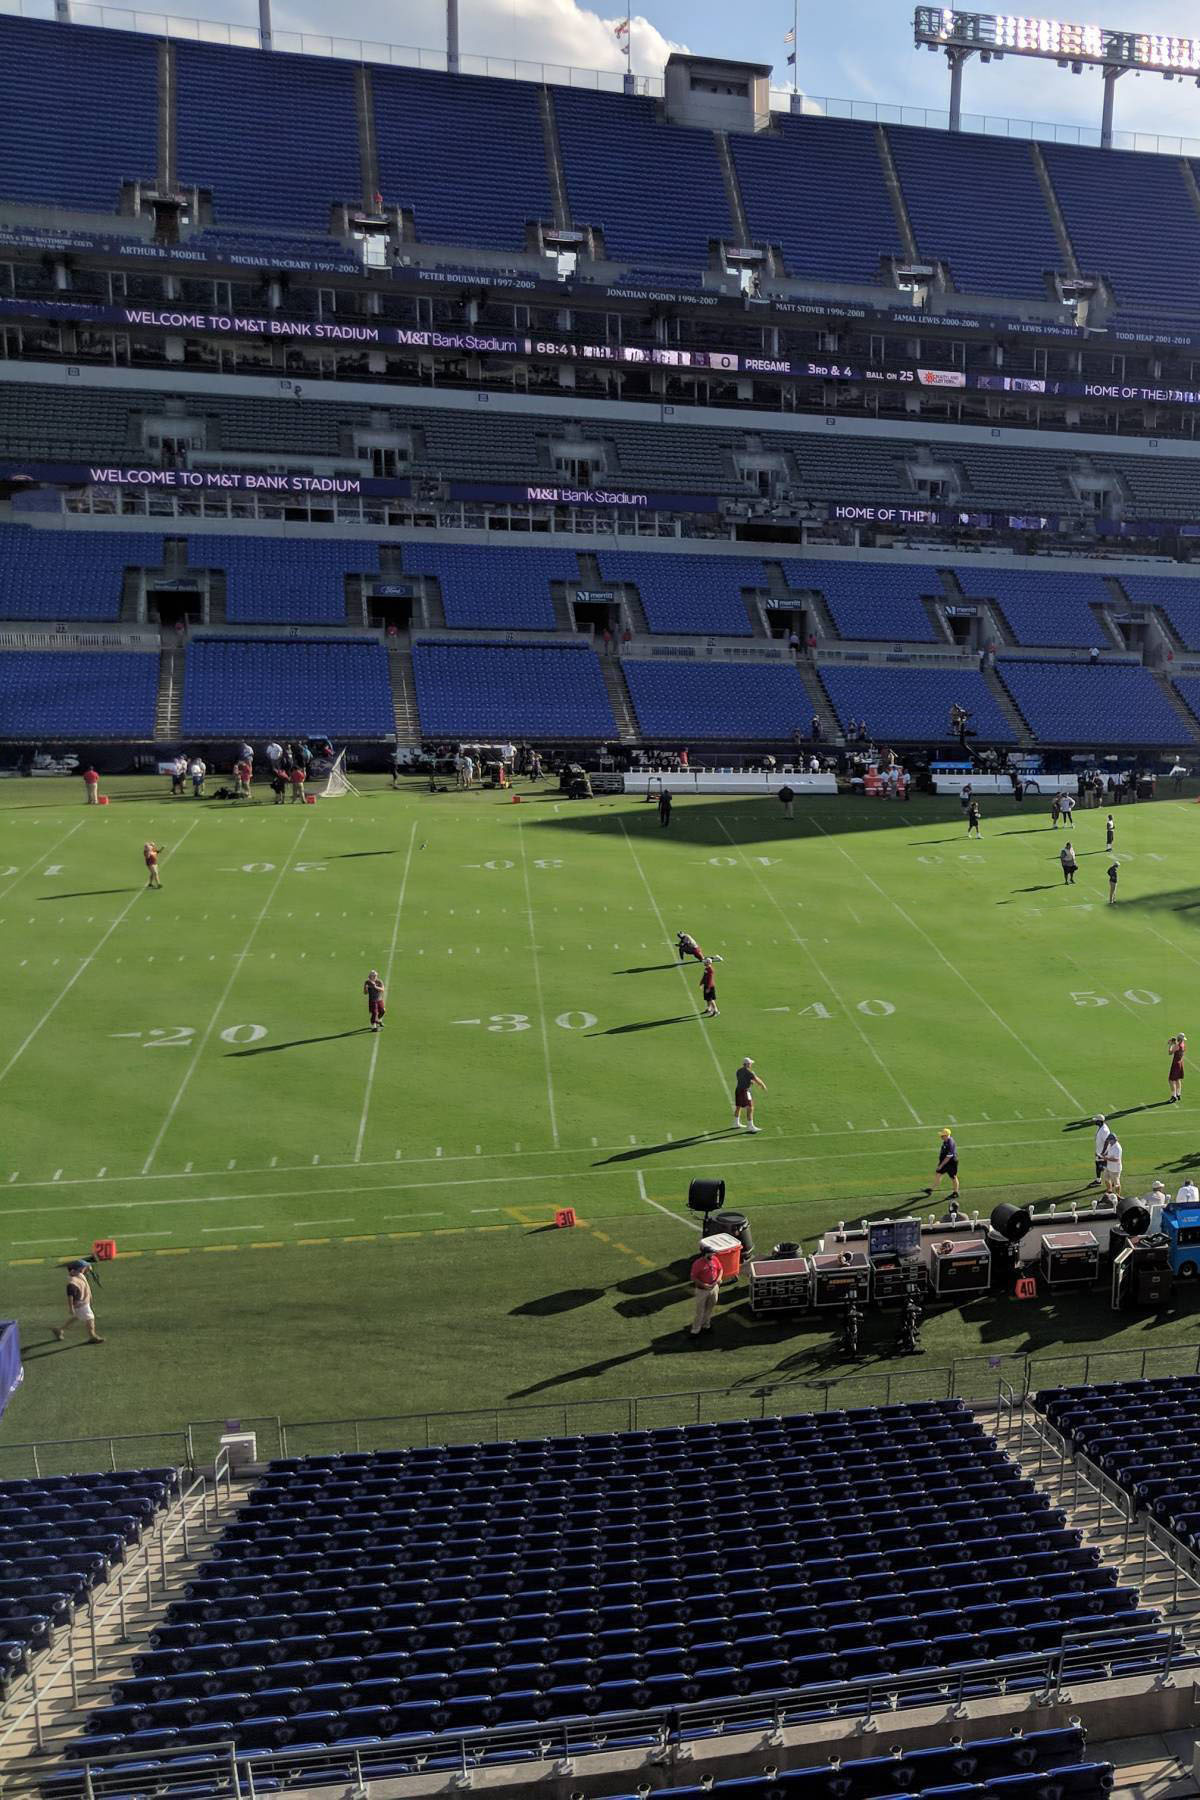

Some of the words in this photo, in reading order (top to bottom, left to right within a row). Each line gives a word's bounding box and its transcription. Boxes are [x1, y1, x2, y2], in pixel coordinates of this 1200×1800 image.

[120, 246, 157, 256] ARTHUR
[159, 248, 168, 256] B.
[170, 250, 208, 261] MODELL
[230, 255, 269, 266] MICHAEL
[271, 260, 311, 270] McCRARY
[314, 263, 360, 274] 1997-2002
[419, 271, 445, 281] PETER
[447, 274, 491, 285] BOULWARE
[606, 288, 647, 299] JONATHAN
[649, 293, 676, 302] OGDEN
[776, 303, 795, 312] MATT
[797, 305, 825, 314] STOVER
[126, 310, 205, 329] WELCOME
[209, 316, 231, 330] TO
[235, 318, 268, 333] M&T
[271, 321, 311, 336] BANK
[315, 324, 379, 341] STADIUM
[894, 314, 917, 323] JAMAL
[919, 316, 940, 324] LEWIS
[1022, 325, 1042, 333] LEWIS
[1116, 332, 1134, 340] TODD
[397, 330, 431, 345] M&T
[433, 333, 465, 348] Bank
[465, 336, 517, 353] Stadium
[720, 356, 731, 368] 0
[745, 357, 791, 373] PREGAME
[807, 362, 828, 376] 3RD
[830, 365, 841, 377] &
[843, 365, 853, 378] 4
[866, 370, 884, 380] BALL
[886, 373, 897, 381] ON
[899, 370, 914, 382] 25
[1085, 384, 1119, 398] HOME
[1122, 387, 1138, 399] OF
[1141, 388, 1163, 400] THE
[90, 468, 175, 485] WELCOME
[180, 472, 203, 486] TO
[207, 474, 241, 487] M&T
[245, 475, 288, 489] BANK
[292, 478, 360, 493] STADIUM
[527, 487, 558, 500] M&T
[561, 488, 593, 502] Bank
[594, 489, 647, 506] Stadium
[836, 506, 874, 520] HOME
[877, 508, 896, 521] OF
[899, 510, 925, 522] THE
[558, 1210, 574, 1226] 30
[1020, 1281, 1033, 1297] 40
